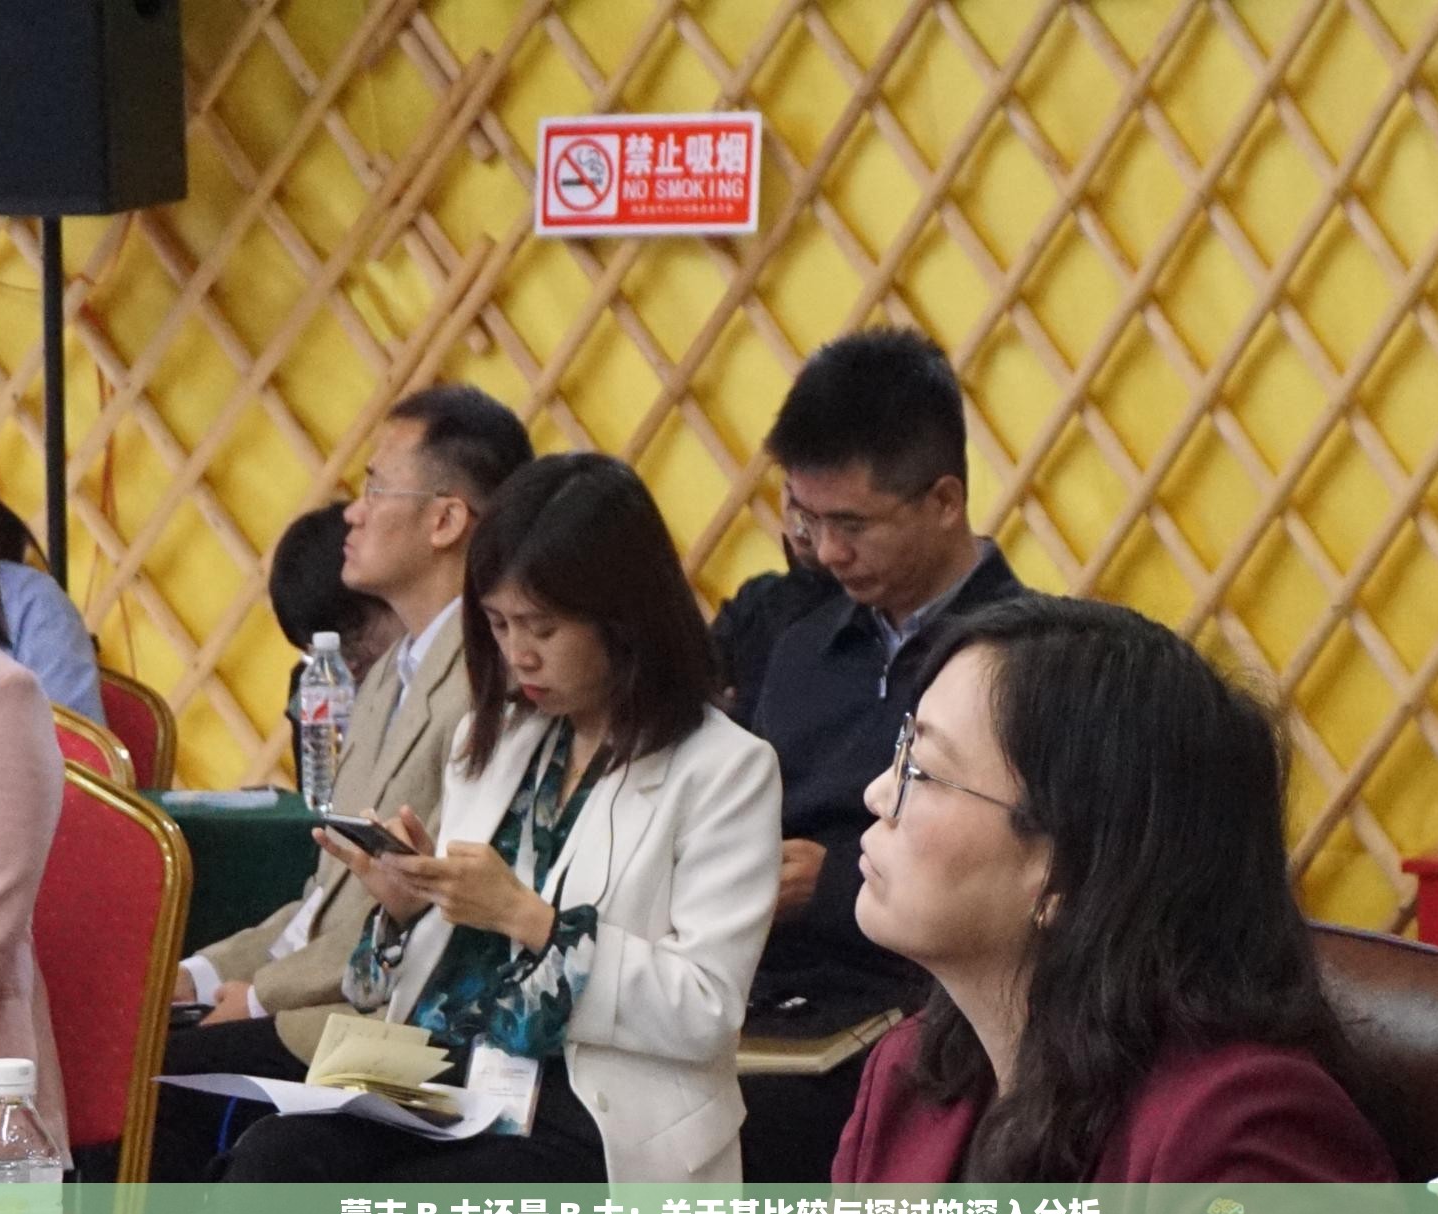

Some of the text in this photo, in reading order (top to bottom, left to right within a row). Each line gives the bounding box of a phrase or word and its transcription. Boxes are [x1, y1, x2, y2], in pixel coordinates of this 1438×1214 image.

[624, 132, 747, 176] 禁止吸烟
[622, 176, 744, 199] NO SMOKING
